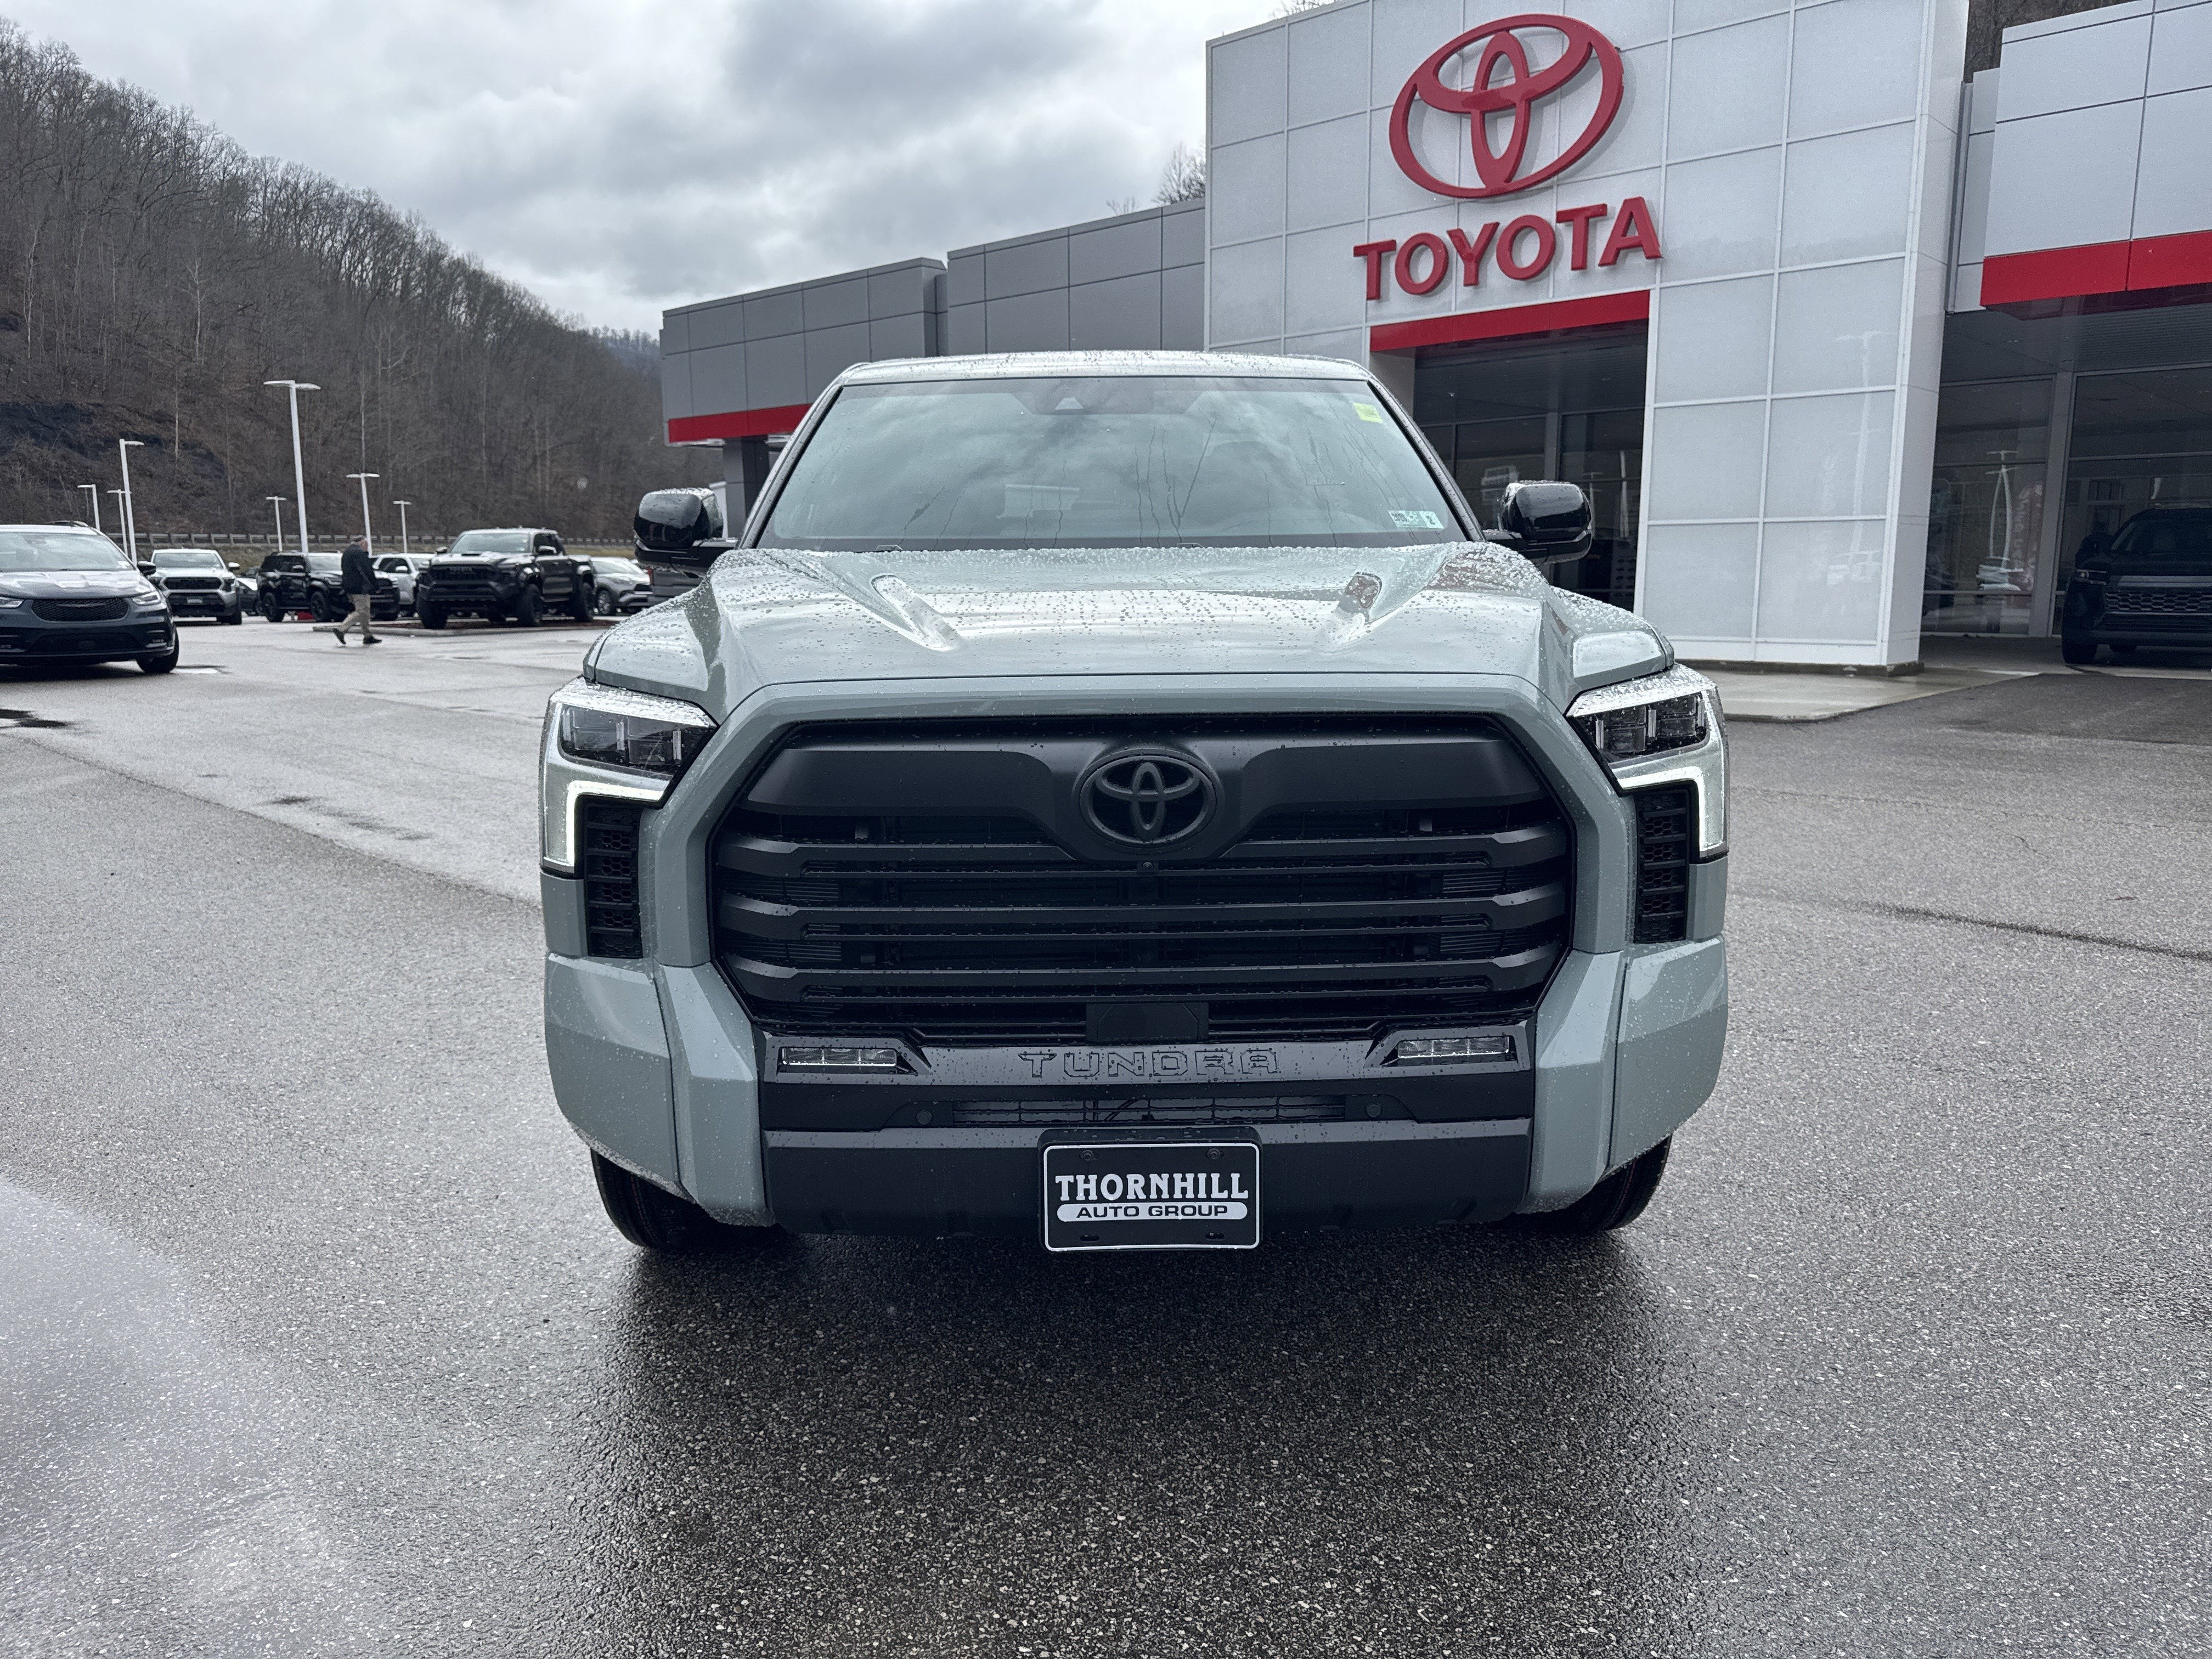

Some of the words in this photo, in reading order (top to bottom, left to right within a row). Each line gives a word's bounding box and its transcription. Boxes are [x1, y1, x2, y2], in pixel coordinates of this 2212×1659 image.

[1353, 196, 1663, 301] TOYOTA
[1426, 516, 1435, 525] 2
[1018, 1049, 1279, 1078] TUNDRA
[1055, 1172, 1249, 1201] THORNHILL
[1076, 1205, 1140, 1219] AUTO
[1147, 1204, 1228, 1218] GROUP
